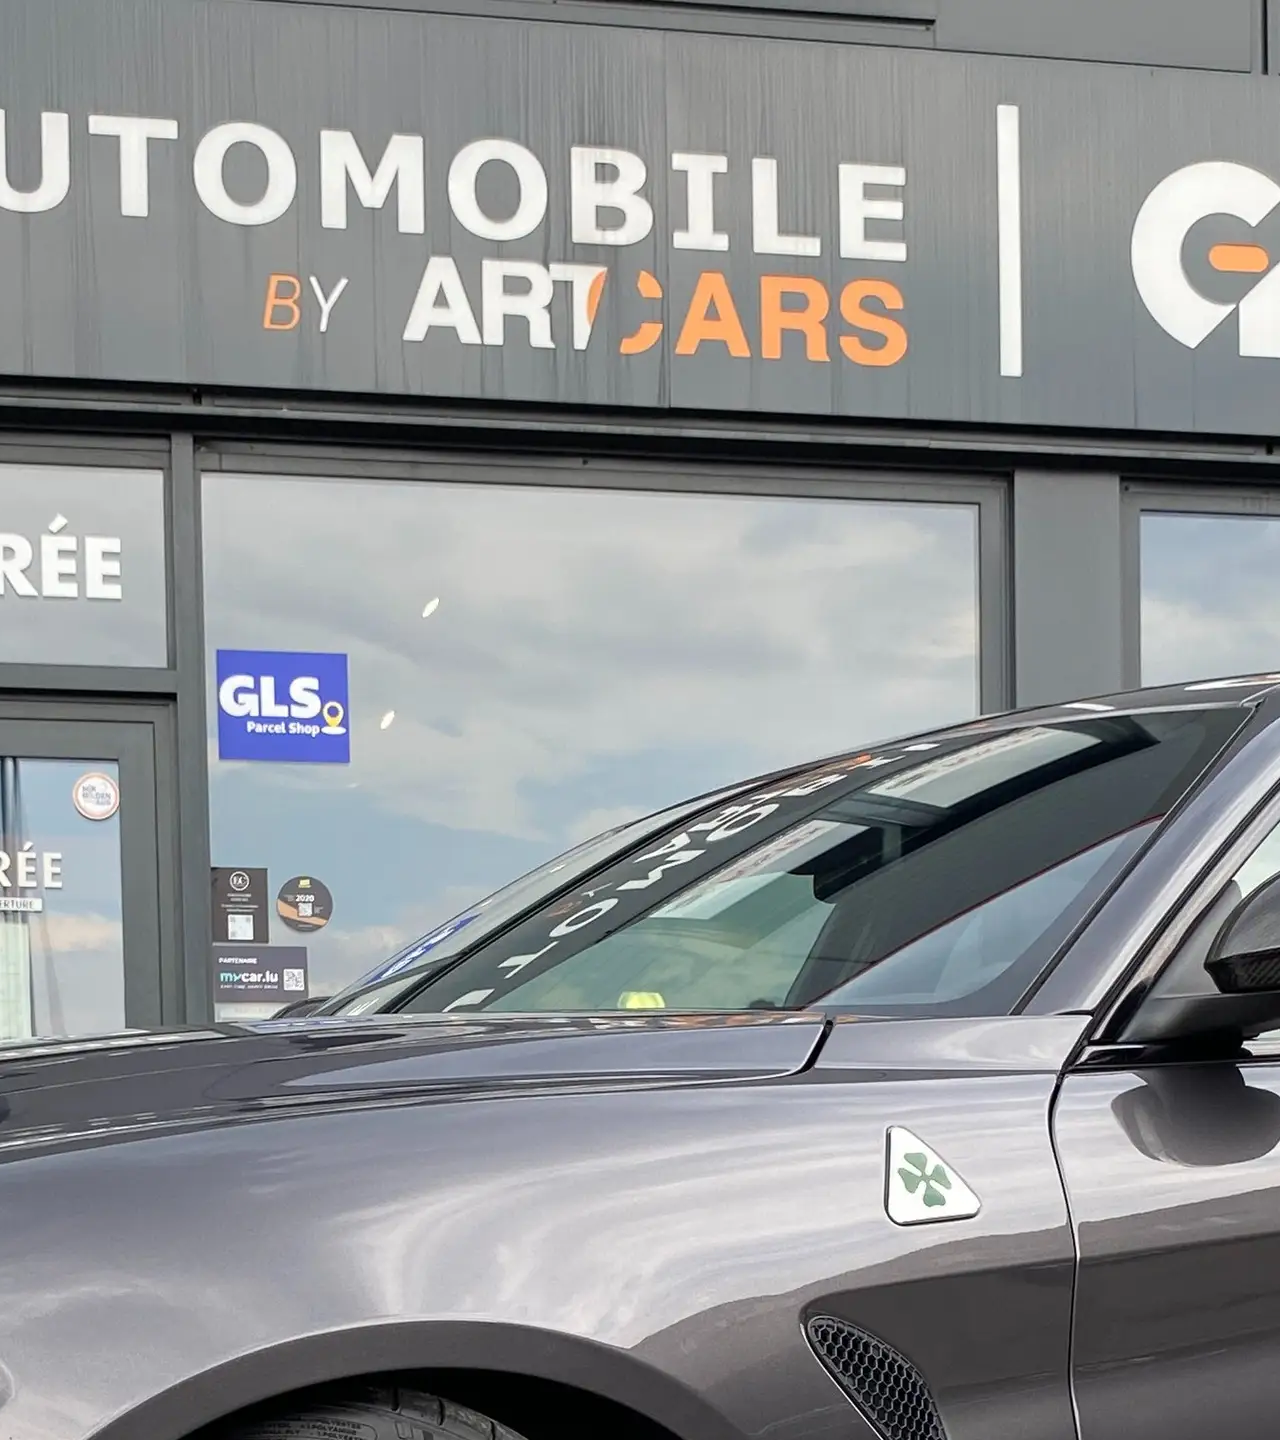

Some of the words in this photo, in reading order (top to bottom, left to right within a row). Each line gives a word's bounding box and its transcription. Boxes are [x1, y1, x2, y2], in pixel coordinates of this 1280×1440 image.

[262, 273, 349, 333] BY
[219, 674, 322, 719] GLS
[246, 721, 287, 734] Parcel
[288, 722, 320, 738] Shop
[220, 970, 279, 983] mycar.lu
